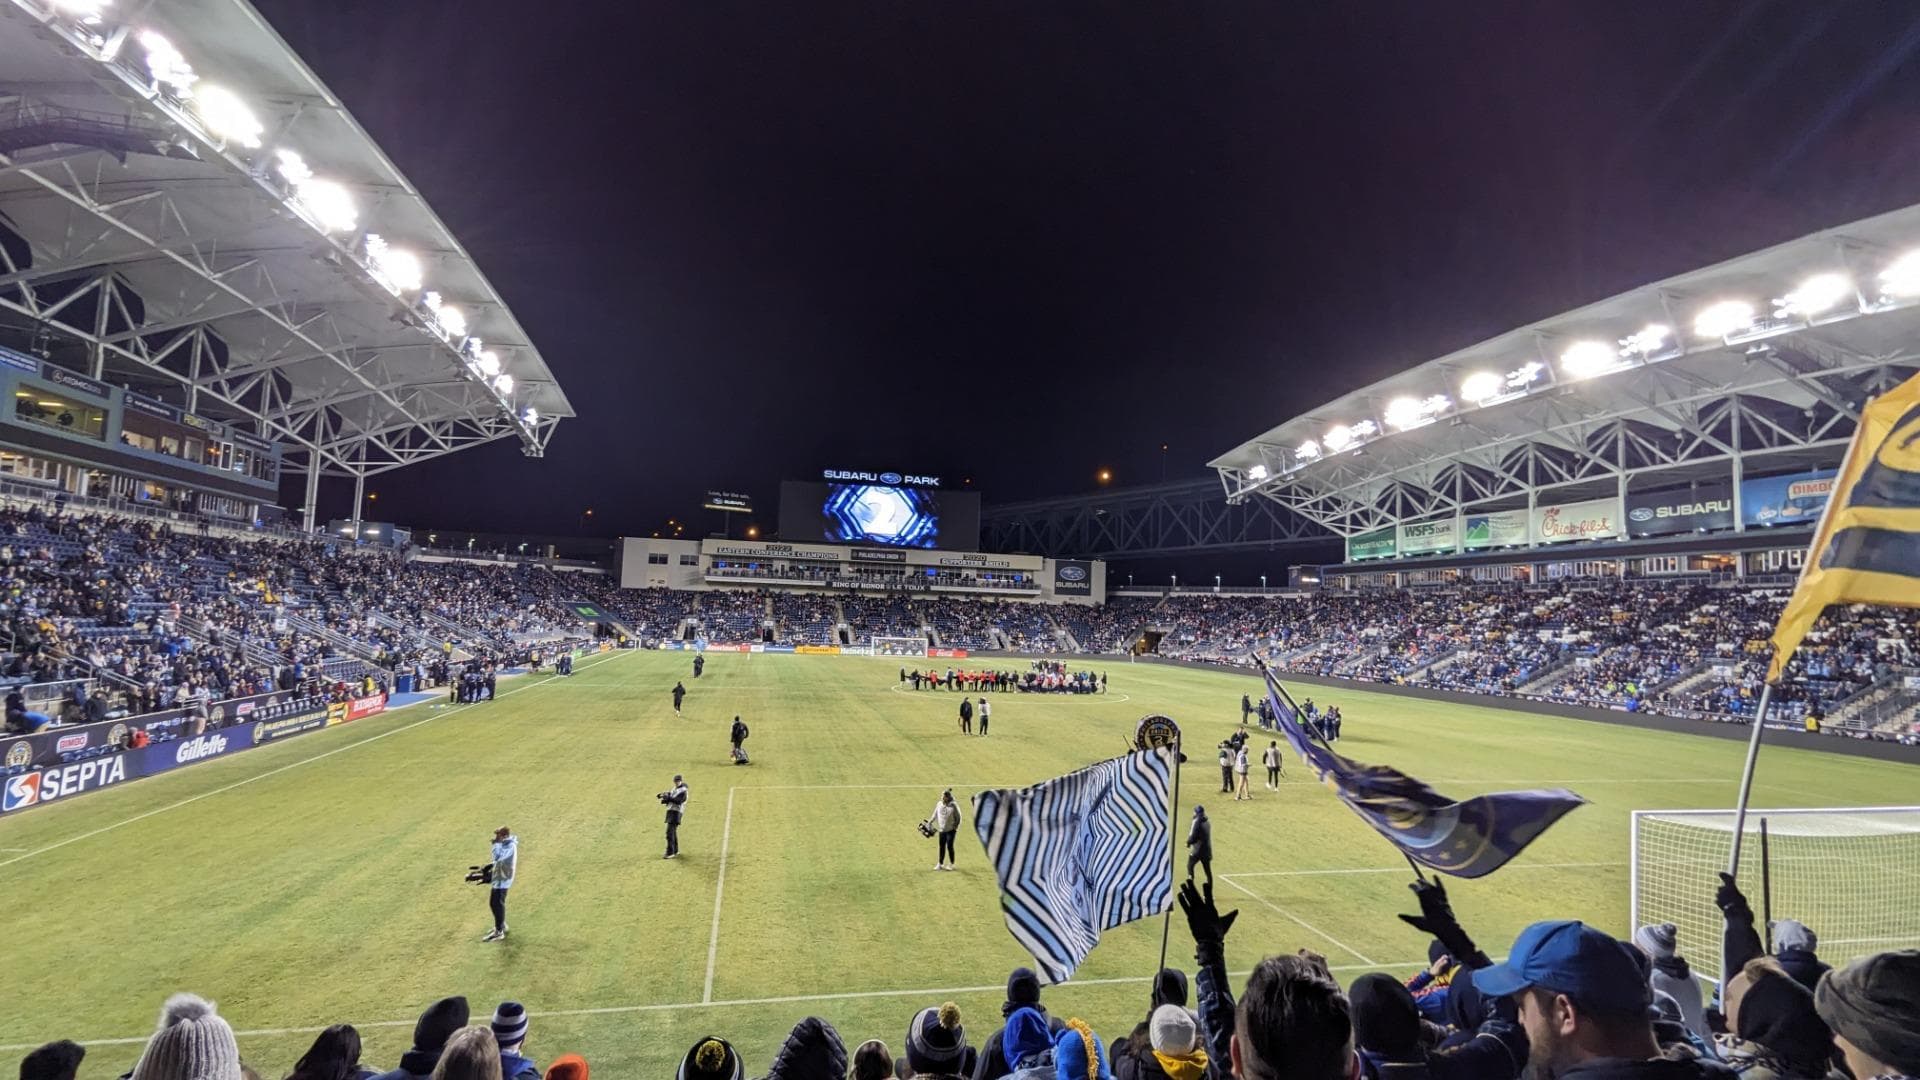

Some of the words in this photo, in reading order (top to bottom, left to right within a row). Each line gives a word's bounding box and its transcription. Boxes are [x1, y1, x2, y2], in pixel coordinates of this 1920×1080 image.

[824, 469, 877, 481] SUBARU
[904, 475, 939, 485] PARK
[1656, 500, 1731, 519] SUBARU
[1404, 523, 1435, 538] WSFS
[1435, 524, 1451, 534] bank
[1541, 513, 1612, 538] Chick-fil-A
[717, 546, 750, 555] EASTERN
[750, 549, 796, 558] CONFERENCE
[797, 551, 839, 560] CHAMPIONS
[1055, 581, 1090, 589] SUBARU
[60, 736, 85, 749] BIMBO
[175, 733, 228, 763] Gillette
[40, 754, 126, 801] SEPTA
